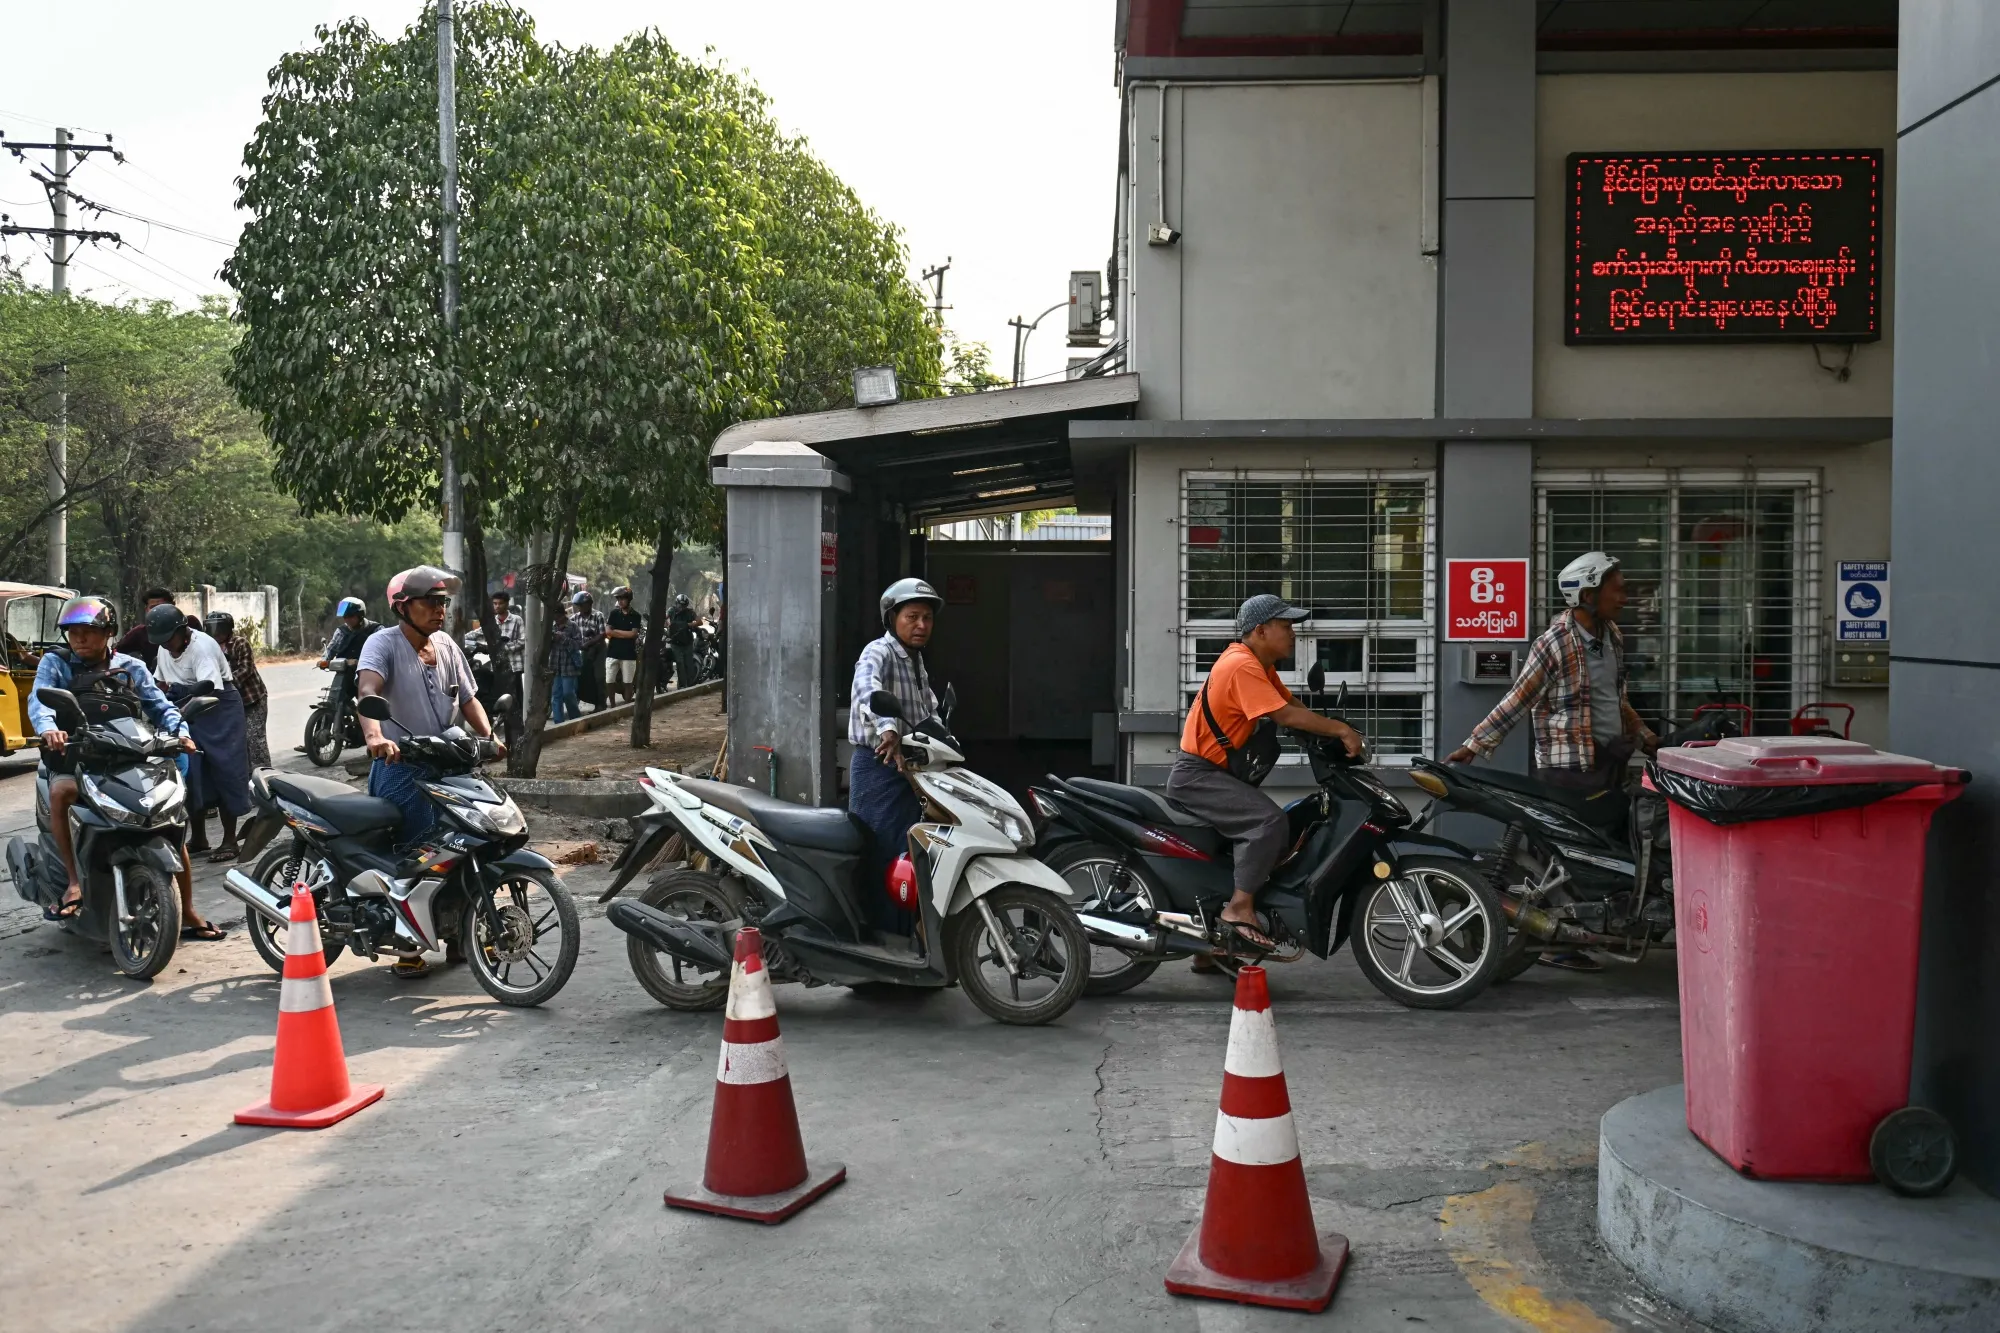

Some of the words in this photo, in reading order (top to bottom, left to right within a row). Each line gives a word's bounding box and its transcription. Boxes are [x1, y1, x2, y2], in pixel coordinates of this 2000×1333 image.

[1470, 567, 1505, 603] မီး
[1456, 610, 1517, 634] သတိပြုပါ
[1845, 621, 1863, 629] SAFETY
[1864, 621, 1880, 629] SHOES
